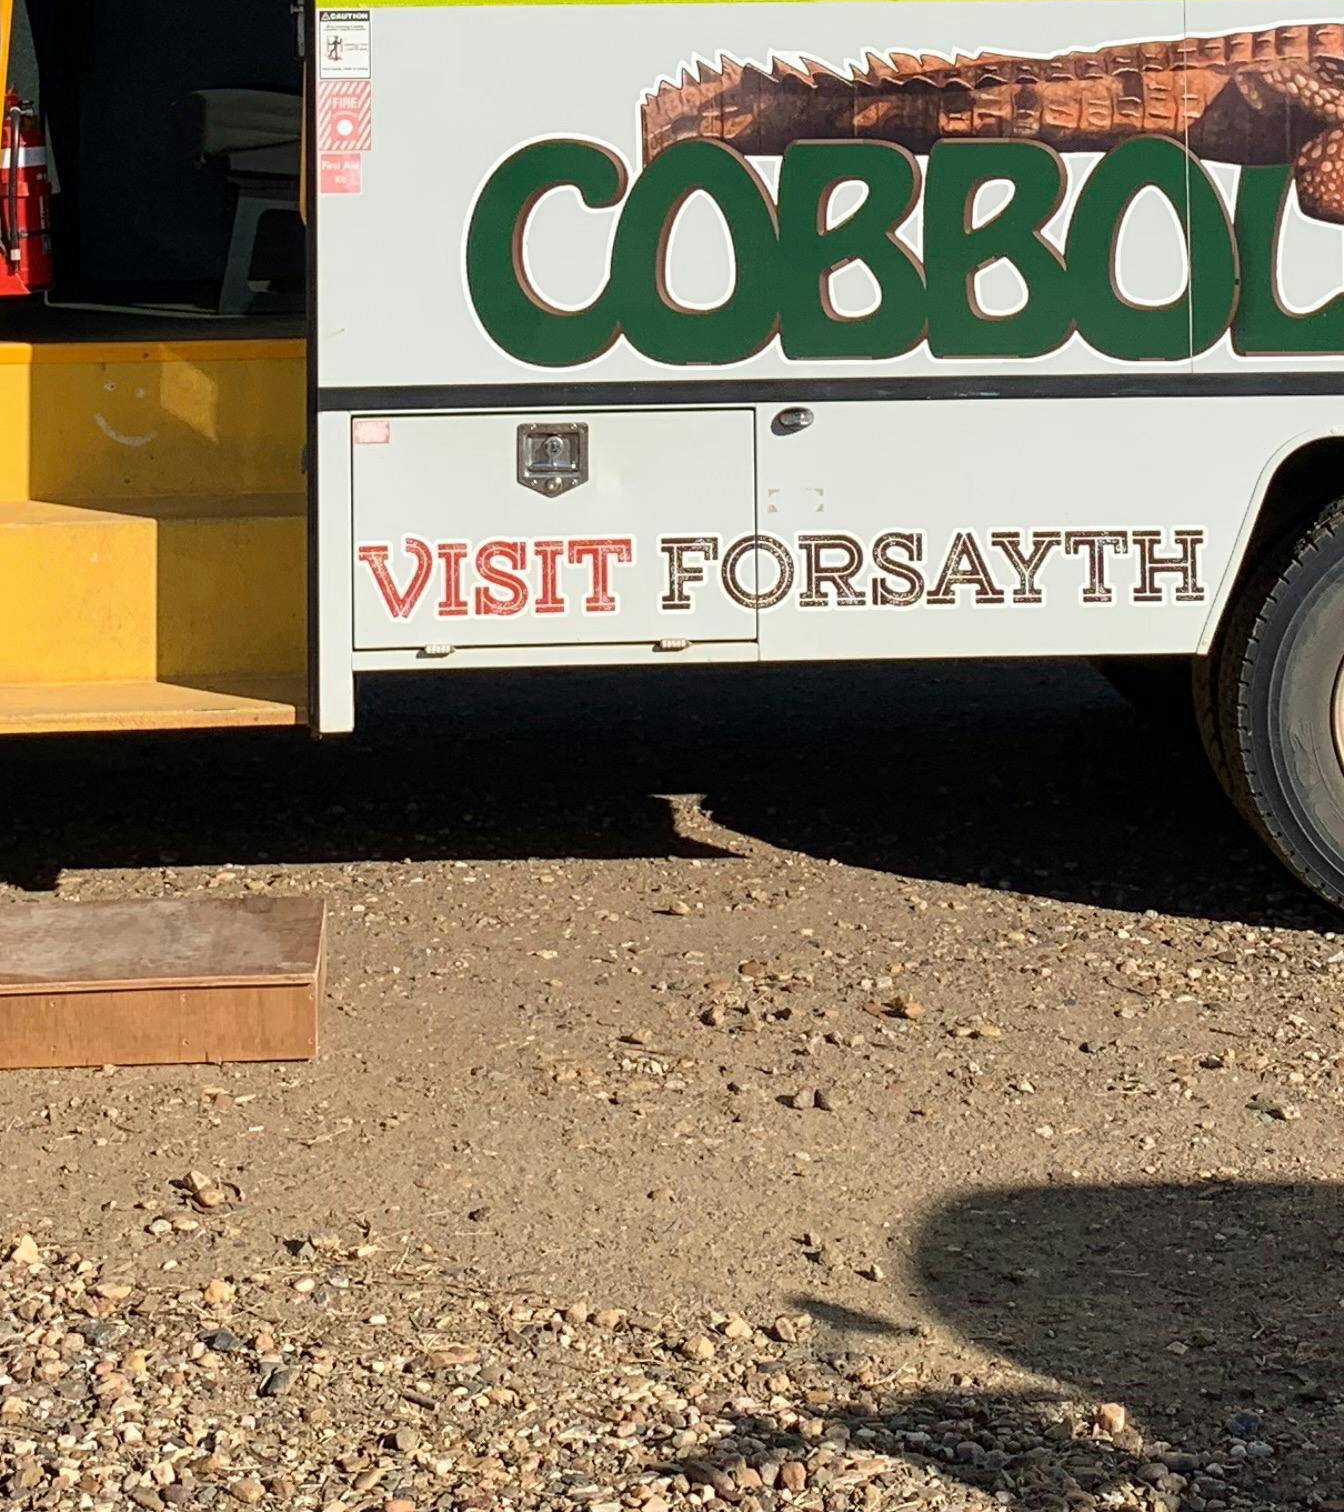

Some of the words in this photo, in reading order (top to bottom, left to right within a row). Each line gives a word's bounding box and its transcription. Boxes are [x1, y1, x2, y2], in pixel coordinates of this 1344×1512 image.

[330, 13, 368, 21] CAUTION
[332, 96, 358, 108] FIRE
[358, 537, 633, 618] VISIT
[660, 530, 1205, 610] FORSAYTH
